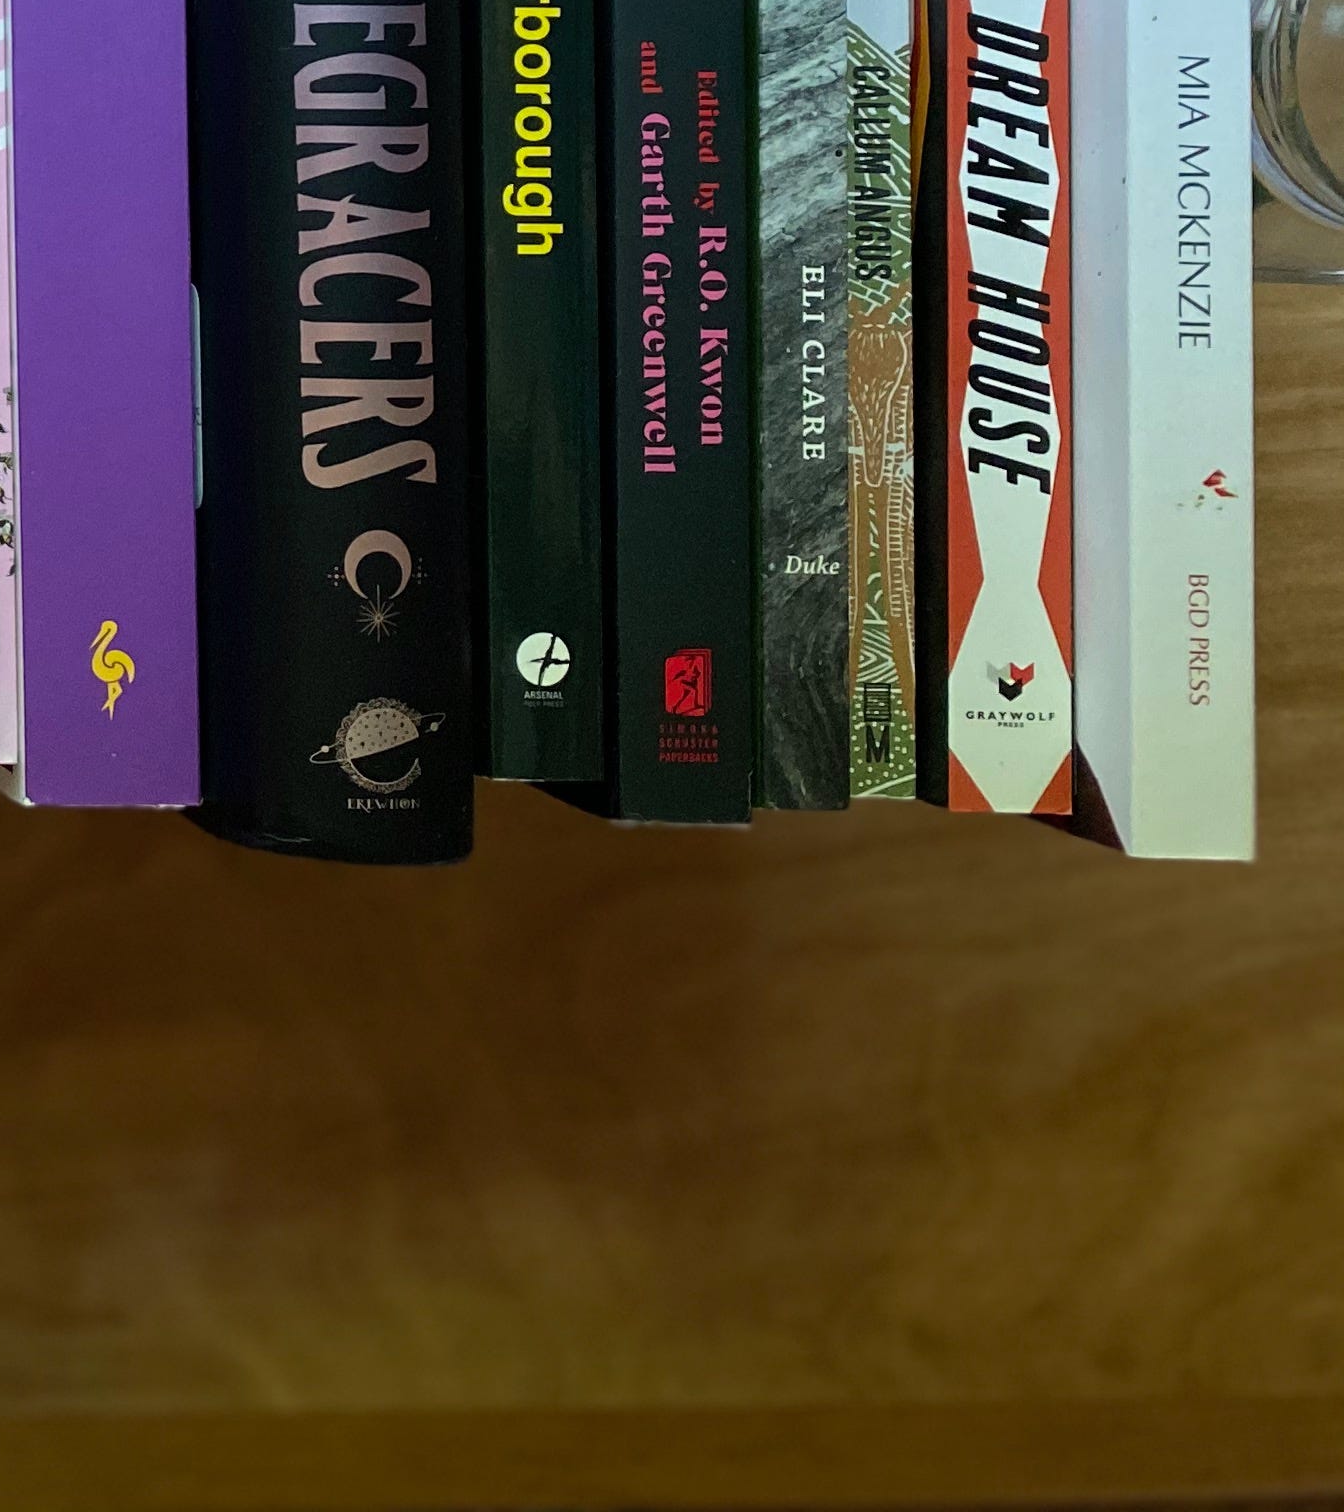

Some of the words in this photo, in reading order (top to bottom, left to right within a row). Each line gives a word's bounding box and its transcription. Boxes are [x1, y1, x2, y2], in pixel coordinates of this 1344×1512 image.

[640, 41, 664, 94] and
[697, 71, 721, 163] Edited
[853, 65, 890, 175] CALLUM
[967, 12, 1050, 247] DREAM
[641, 112, 674, 237] Garth
[693, 182, 720, 215] by
[698, 226, 728, 312] R.O.
[854, 184, 892, 282] ANGUS
[802, 265, 825, 325] ELI
[641, 252, 677, 474] Greenwell
[699, 328, 729, 447] Kwon
[801, 343, 825, 461] CLARE
[967, 270, 1051, 495] HOUSE
[785, 555, 840, 576] Duke
[1187, 574, 1210, 627] BGD
[524, 691, 563, 699] ARSENAL
[1188, 635, 1210, 707] PRESS
[966, 711, 1055, 721] GRAYWOLF
